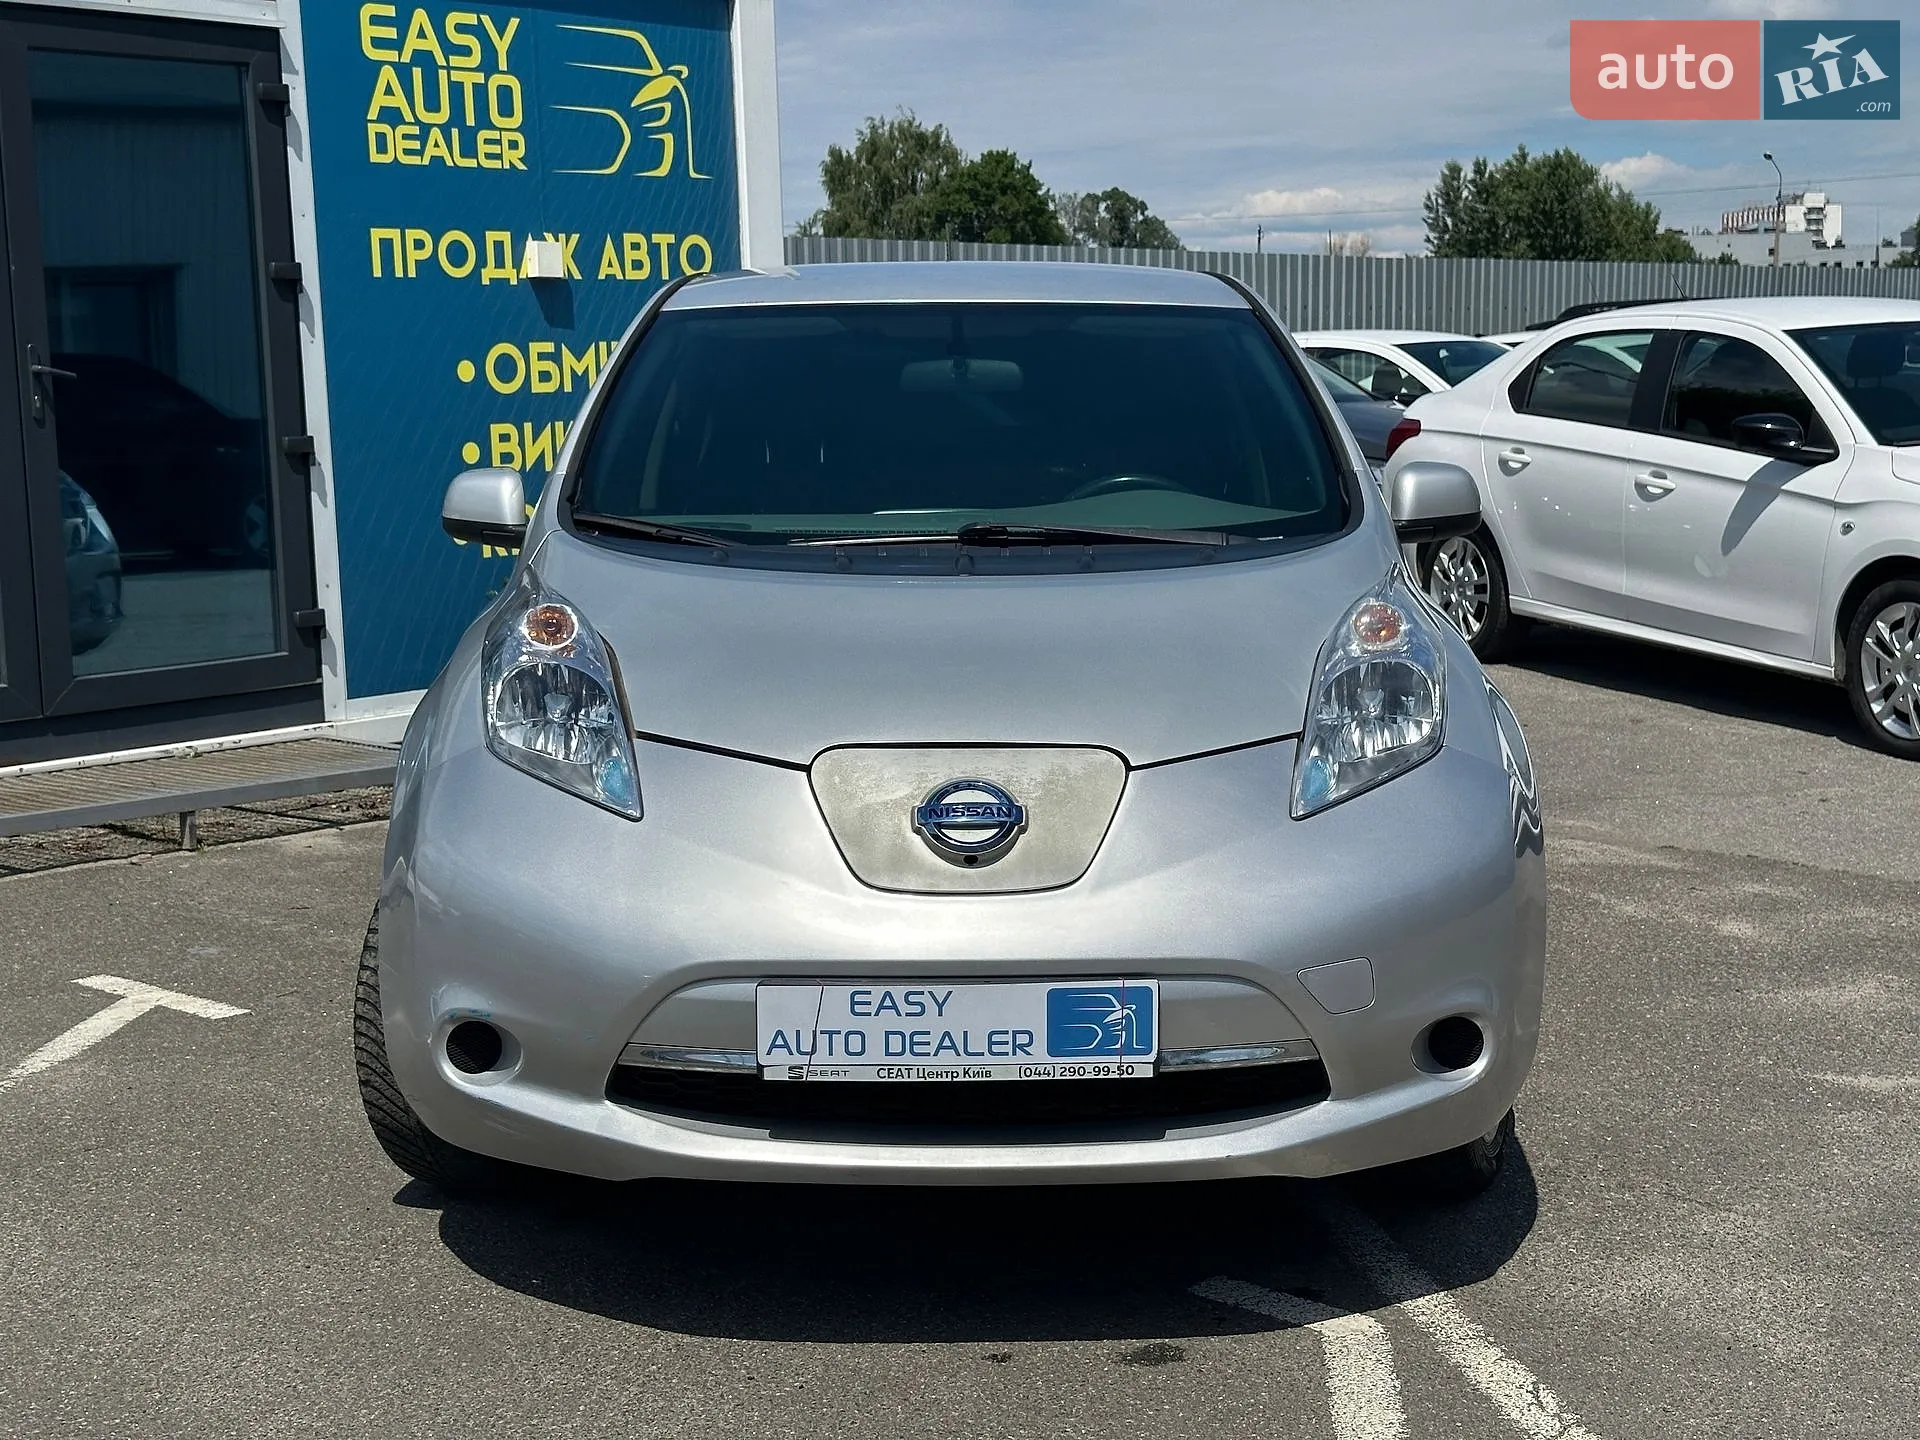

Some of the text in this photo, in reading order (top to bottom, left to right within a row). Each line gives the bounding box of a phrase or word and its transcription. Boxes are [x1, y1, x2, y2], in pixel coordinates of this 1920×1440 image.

[360, 3, 520, 72] EASY
[366, 64, 524, 130] AUTO
[367, 124, 528, 170] DEALER
[598, 232, 713, 281] АВТО
[928, 805, 1012, 819] NISSAN
[849, 990, 953, 1017] EASY
[766, 1029, 1034, 1057] AUTO DEALER
[916, 1067, 960, 1081] Центр
[963, 1066, 992, 1079] Київ
[1059, 1064, 1135, 1077] 290-99-50
